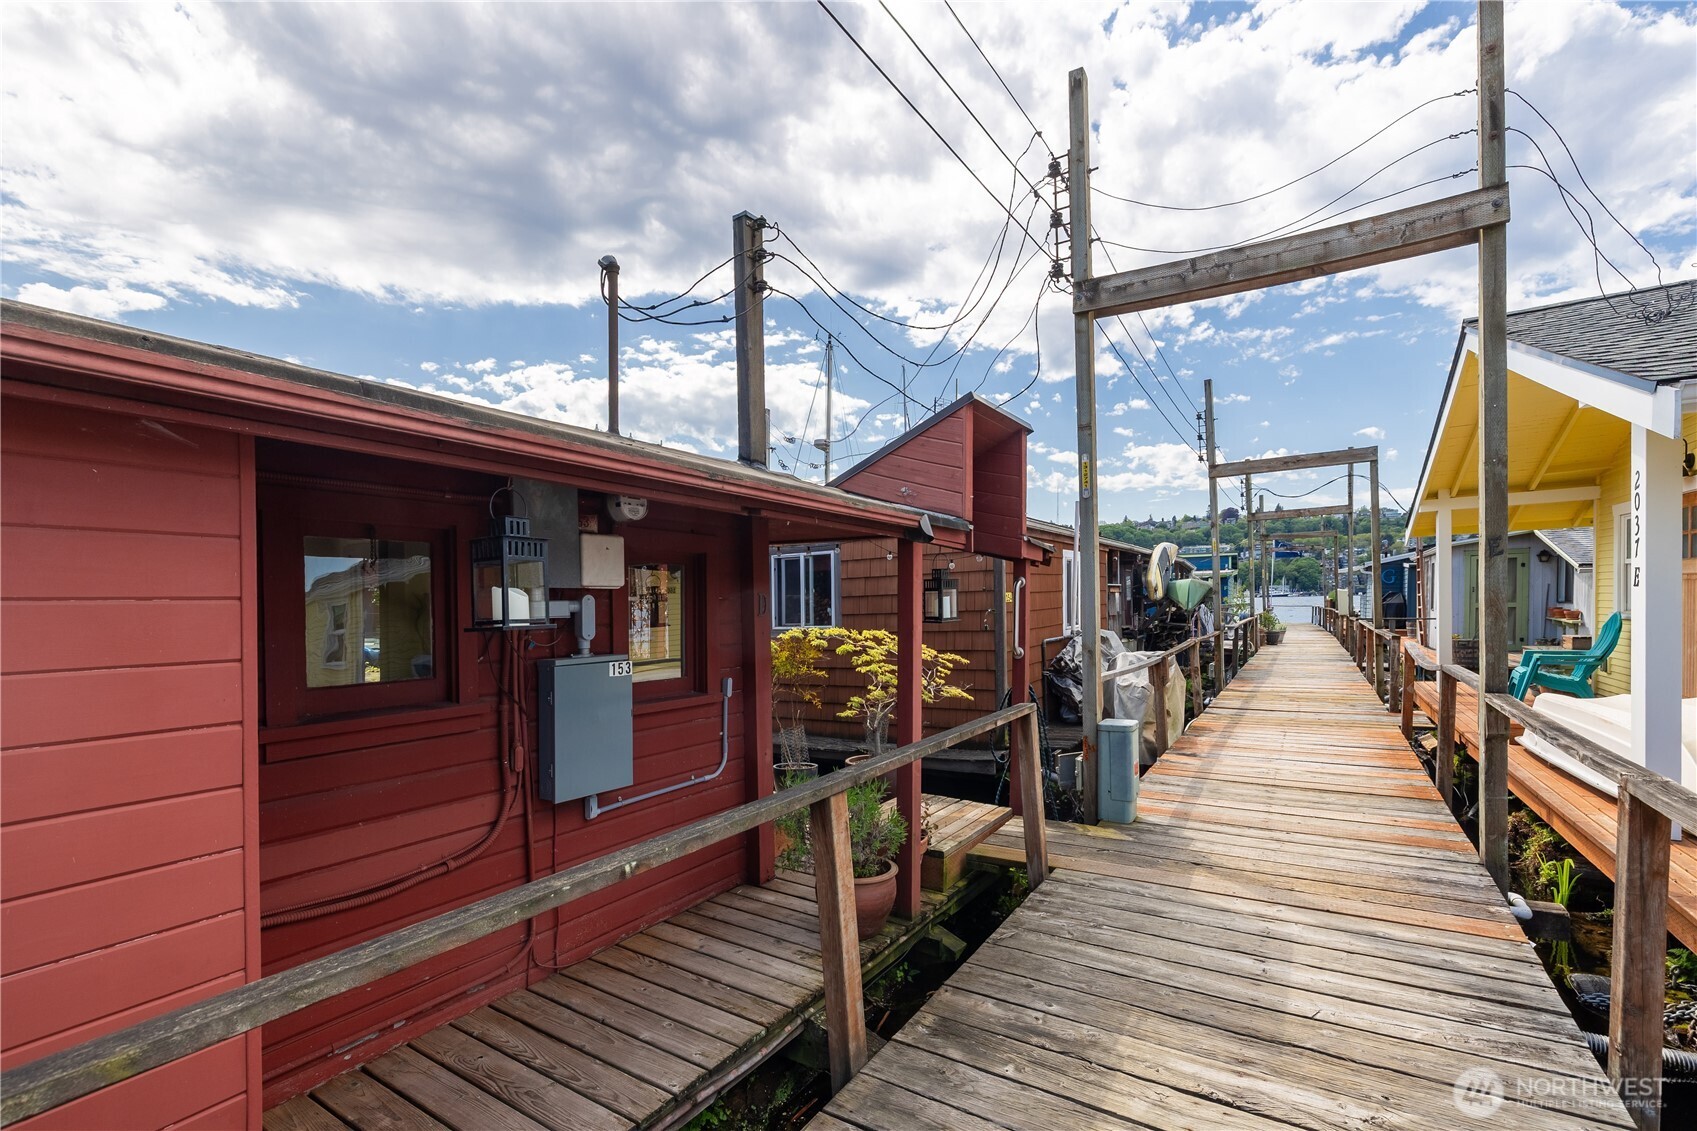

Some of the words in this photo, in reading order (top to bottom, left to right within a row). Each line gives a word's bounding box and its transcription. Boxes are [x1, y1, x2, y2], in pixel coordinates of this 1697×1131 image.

[1382, 568, 1396, 584] G
[1633, 566, 1641, 588] E
[611, 661, 631, 676] 153
